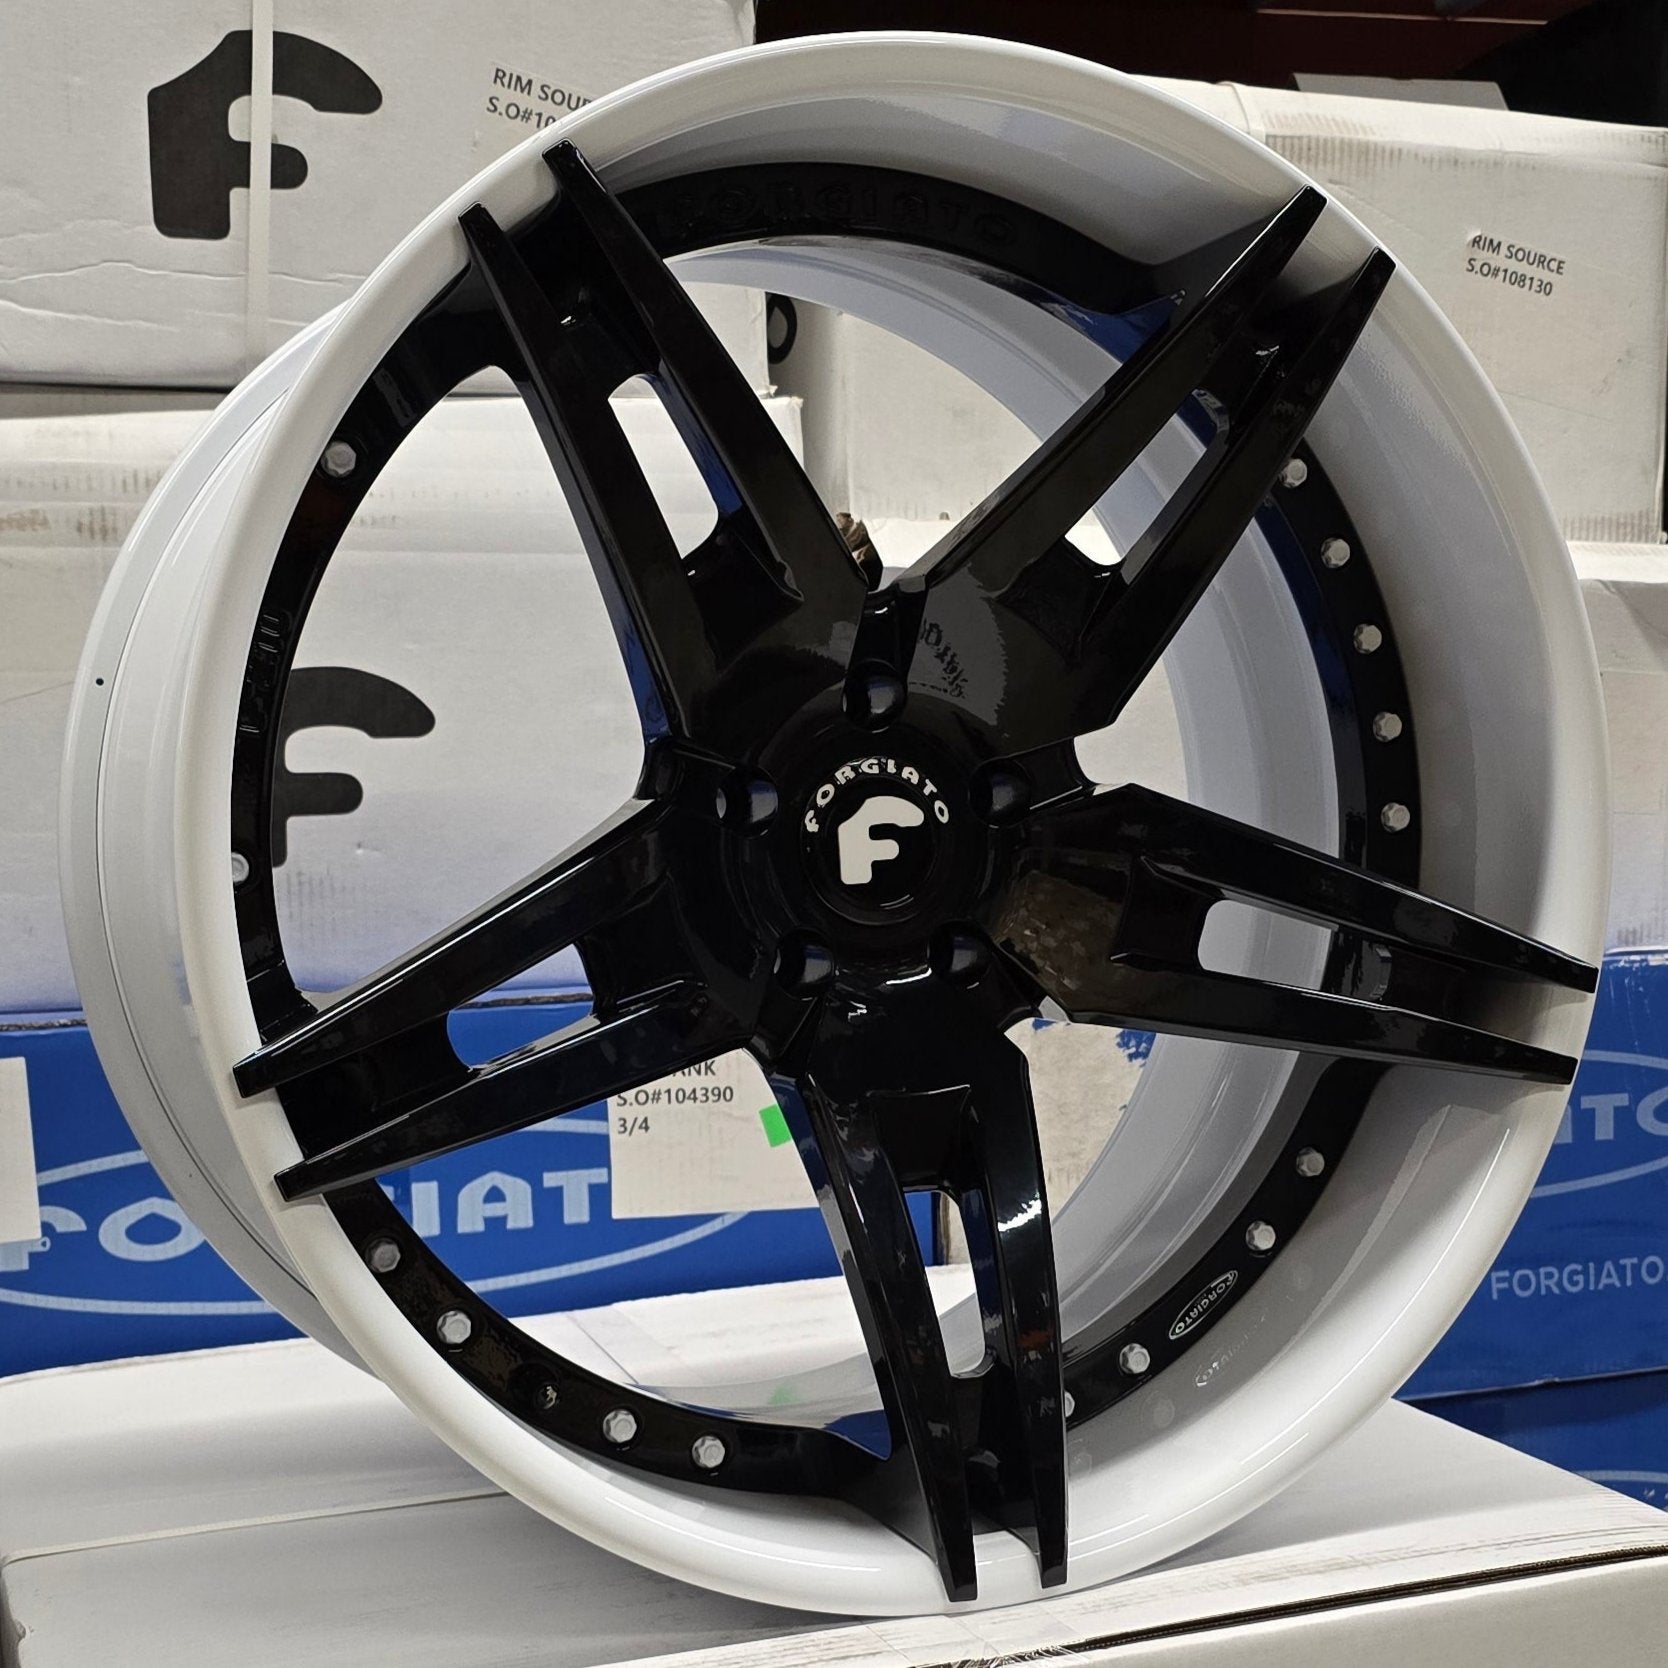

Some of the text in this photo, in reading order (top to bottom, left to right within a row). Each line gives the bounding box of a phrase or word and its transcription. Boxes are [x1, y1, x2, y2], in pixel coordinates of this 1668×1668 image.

[493, 67, 533, 96] RIM
[1471, 234, 1566, 275] RIM SOURCE
[1466, 258, 1553, 296] S.O#108130
[804, 758, 950, 833] FORGIATO
[837, 795, 925, 885] F
[616, 1086, 734, 1107] S.O#104390
[617, 1116, 650, 1137] 3/4
